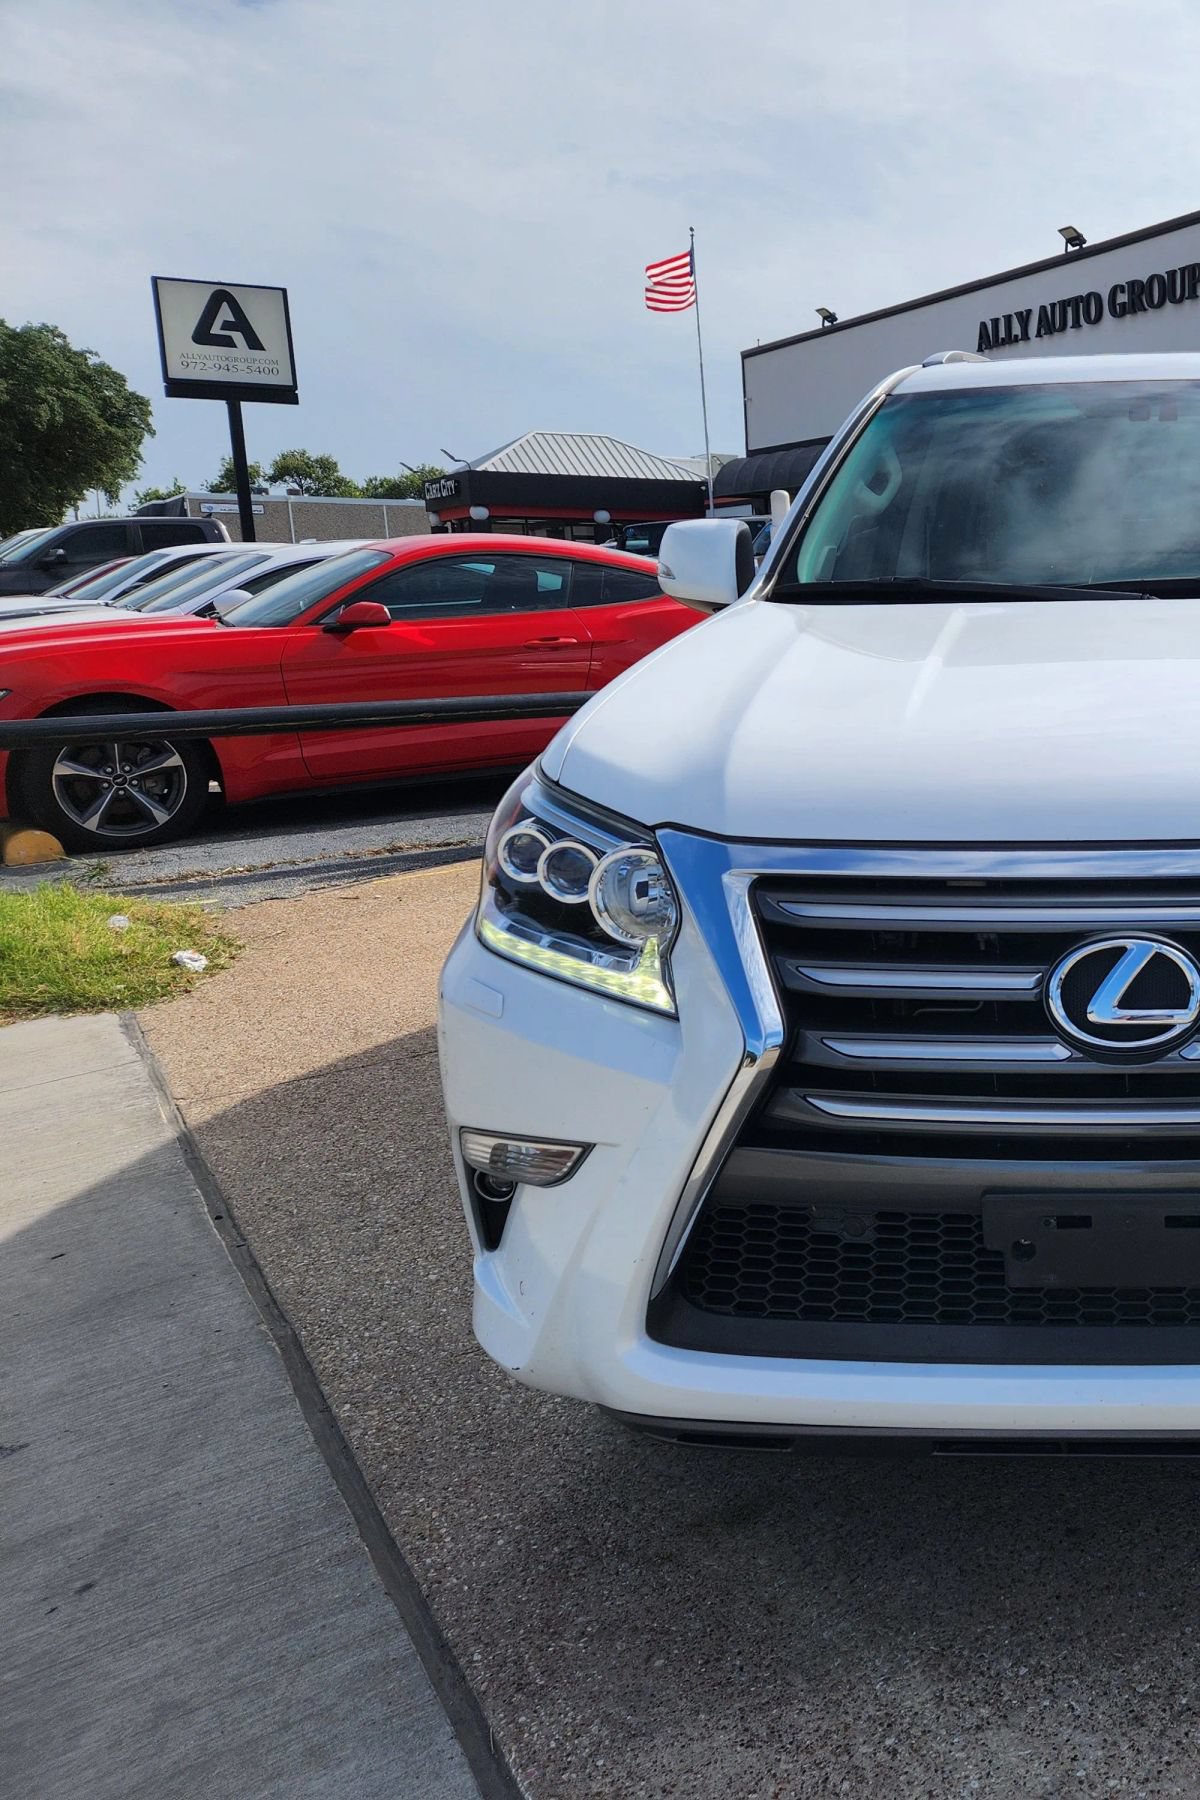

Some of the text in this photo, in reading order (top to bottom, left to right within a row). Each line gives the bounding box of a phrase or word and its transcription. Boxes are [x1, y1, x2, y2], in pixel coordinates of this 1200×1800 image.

[976, 308, 1033, 353] ALLY
[1034, 291, 1104, 338] AUTO
[179, 352, 280, 367] ALLYAUTOGROUP.COM
[180, 360, 281, 377] 972-945-5400
